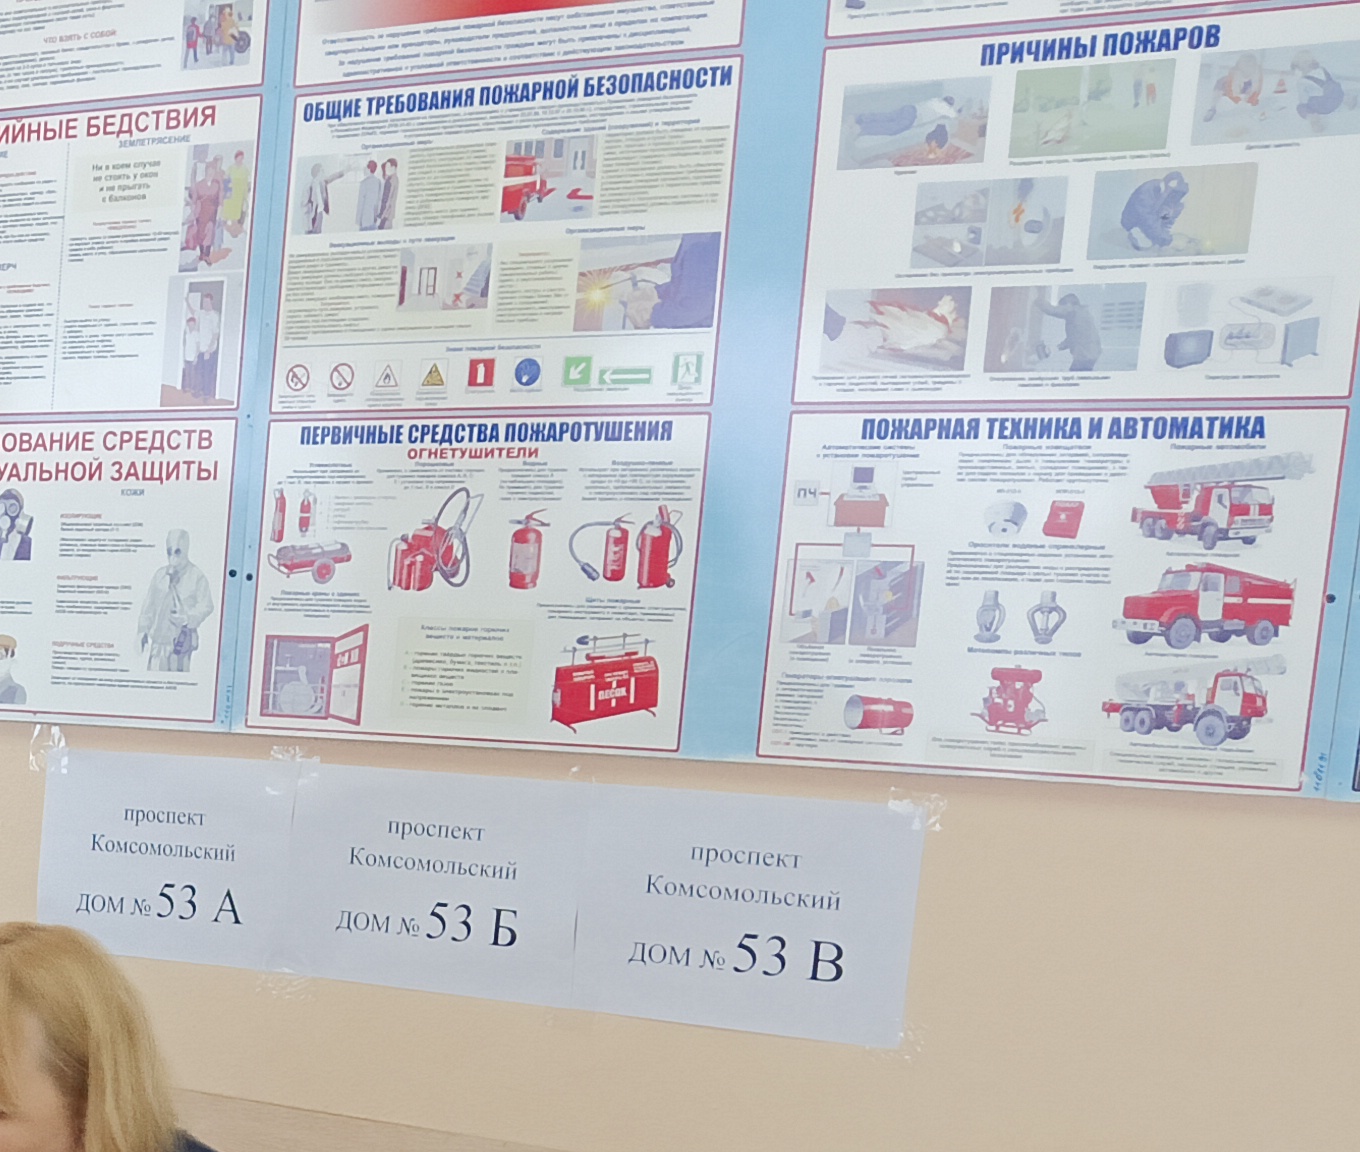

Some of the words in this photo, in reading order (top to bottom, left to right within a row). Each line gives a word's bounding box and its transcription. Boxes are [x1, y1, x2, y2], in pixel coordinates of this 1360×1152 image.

[980, 36, 1097, 67] ПРИЧИНЫ
[1102, 25, 1222, 58] ПОЖАРОВ
[303, 97, 362, 123] ОБЩИЕ
[365, 87, 475, 117] ТРЕБОВАНИЯ
[479, 73, 579, 106] ПОЖАРНОЙ
[583, 65, 733, 97] БЕЗОПАСНОСТИ
[86, 105, 217, 138] БЕДСТВИЯ
[118, 134, 191, 149] ЗЕМЛЕТРЯСЕНИЕ
[102, 429, 213, 454] СРЕДСТВ
[300, 423, 403, 446] ПЕРВИЧНЫЕ
[408, 422, 500, 447] СРЕДСТВА
[504, 420, 673, 444] ПОЖАРОТУШЕНИЯ
[861, 417, 981, 441] ПОЖАРНАЯ
[986, 417, 1083, 440] ТЕХНИКА
[1087, 417, 1103, 440] И
[1108, 416, 1266, 440] АВТОМАТИКА
[407, 446, 540, 461] ОГНЕТУШИТЕЛИ
[109, 459, 218, 485] ЗАЩИТЫ
[598, 687, 627, 700] ПЕСОК
[123, 807, 207, 827] проспект
[387, 818, 486, 842] проспект
[90, 833, 236, 862] Комсомольский
[690, 845, 803, 869] проспект
[348, 846, 517, 881] Комсомольский
[76, 893, 125, 915] ДОМ
[130, 897, 152, 916] №
[156, 883, 197, 920] 53
[212, 888, 243, 925] А
[645, 874, 841, 911] Комсомольский
[335, 910, 390, 934] ДОМ
[396, 915, 420, 937] №
[426, 901, 472, 943] 53
[489, 907, 518, 947] Б
[628, 941, 691, 967] ДОМ
[698, 949, 726, 970] №
[733, 932, 787, 977] 53
[806, 940, 844, 983] В
